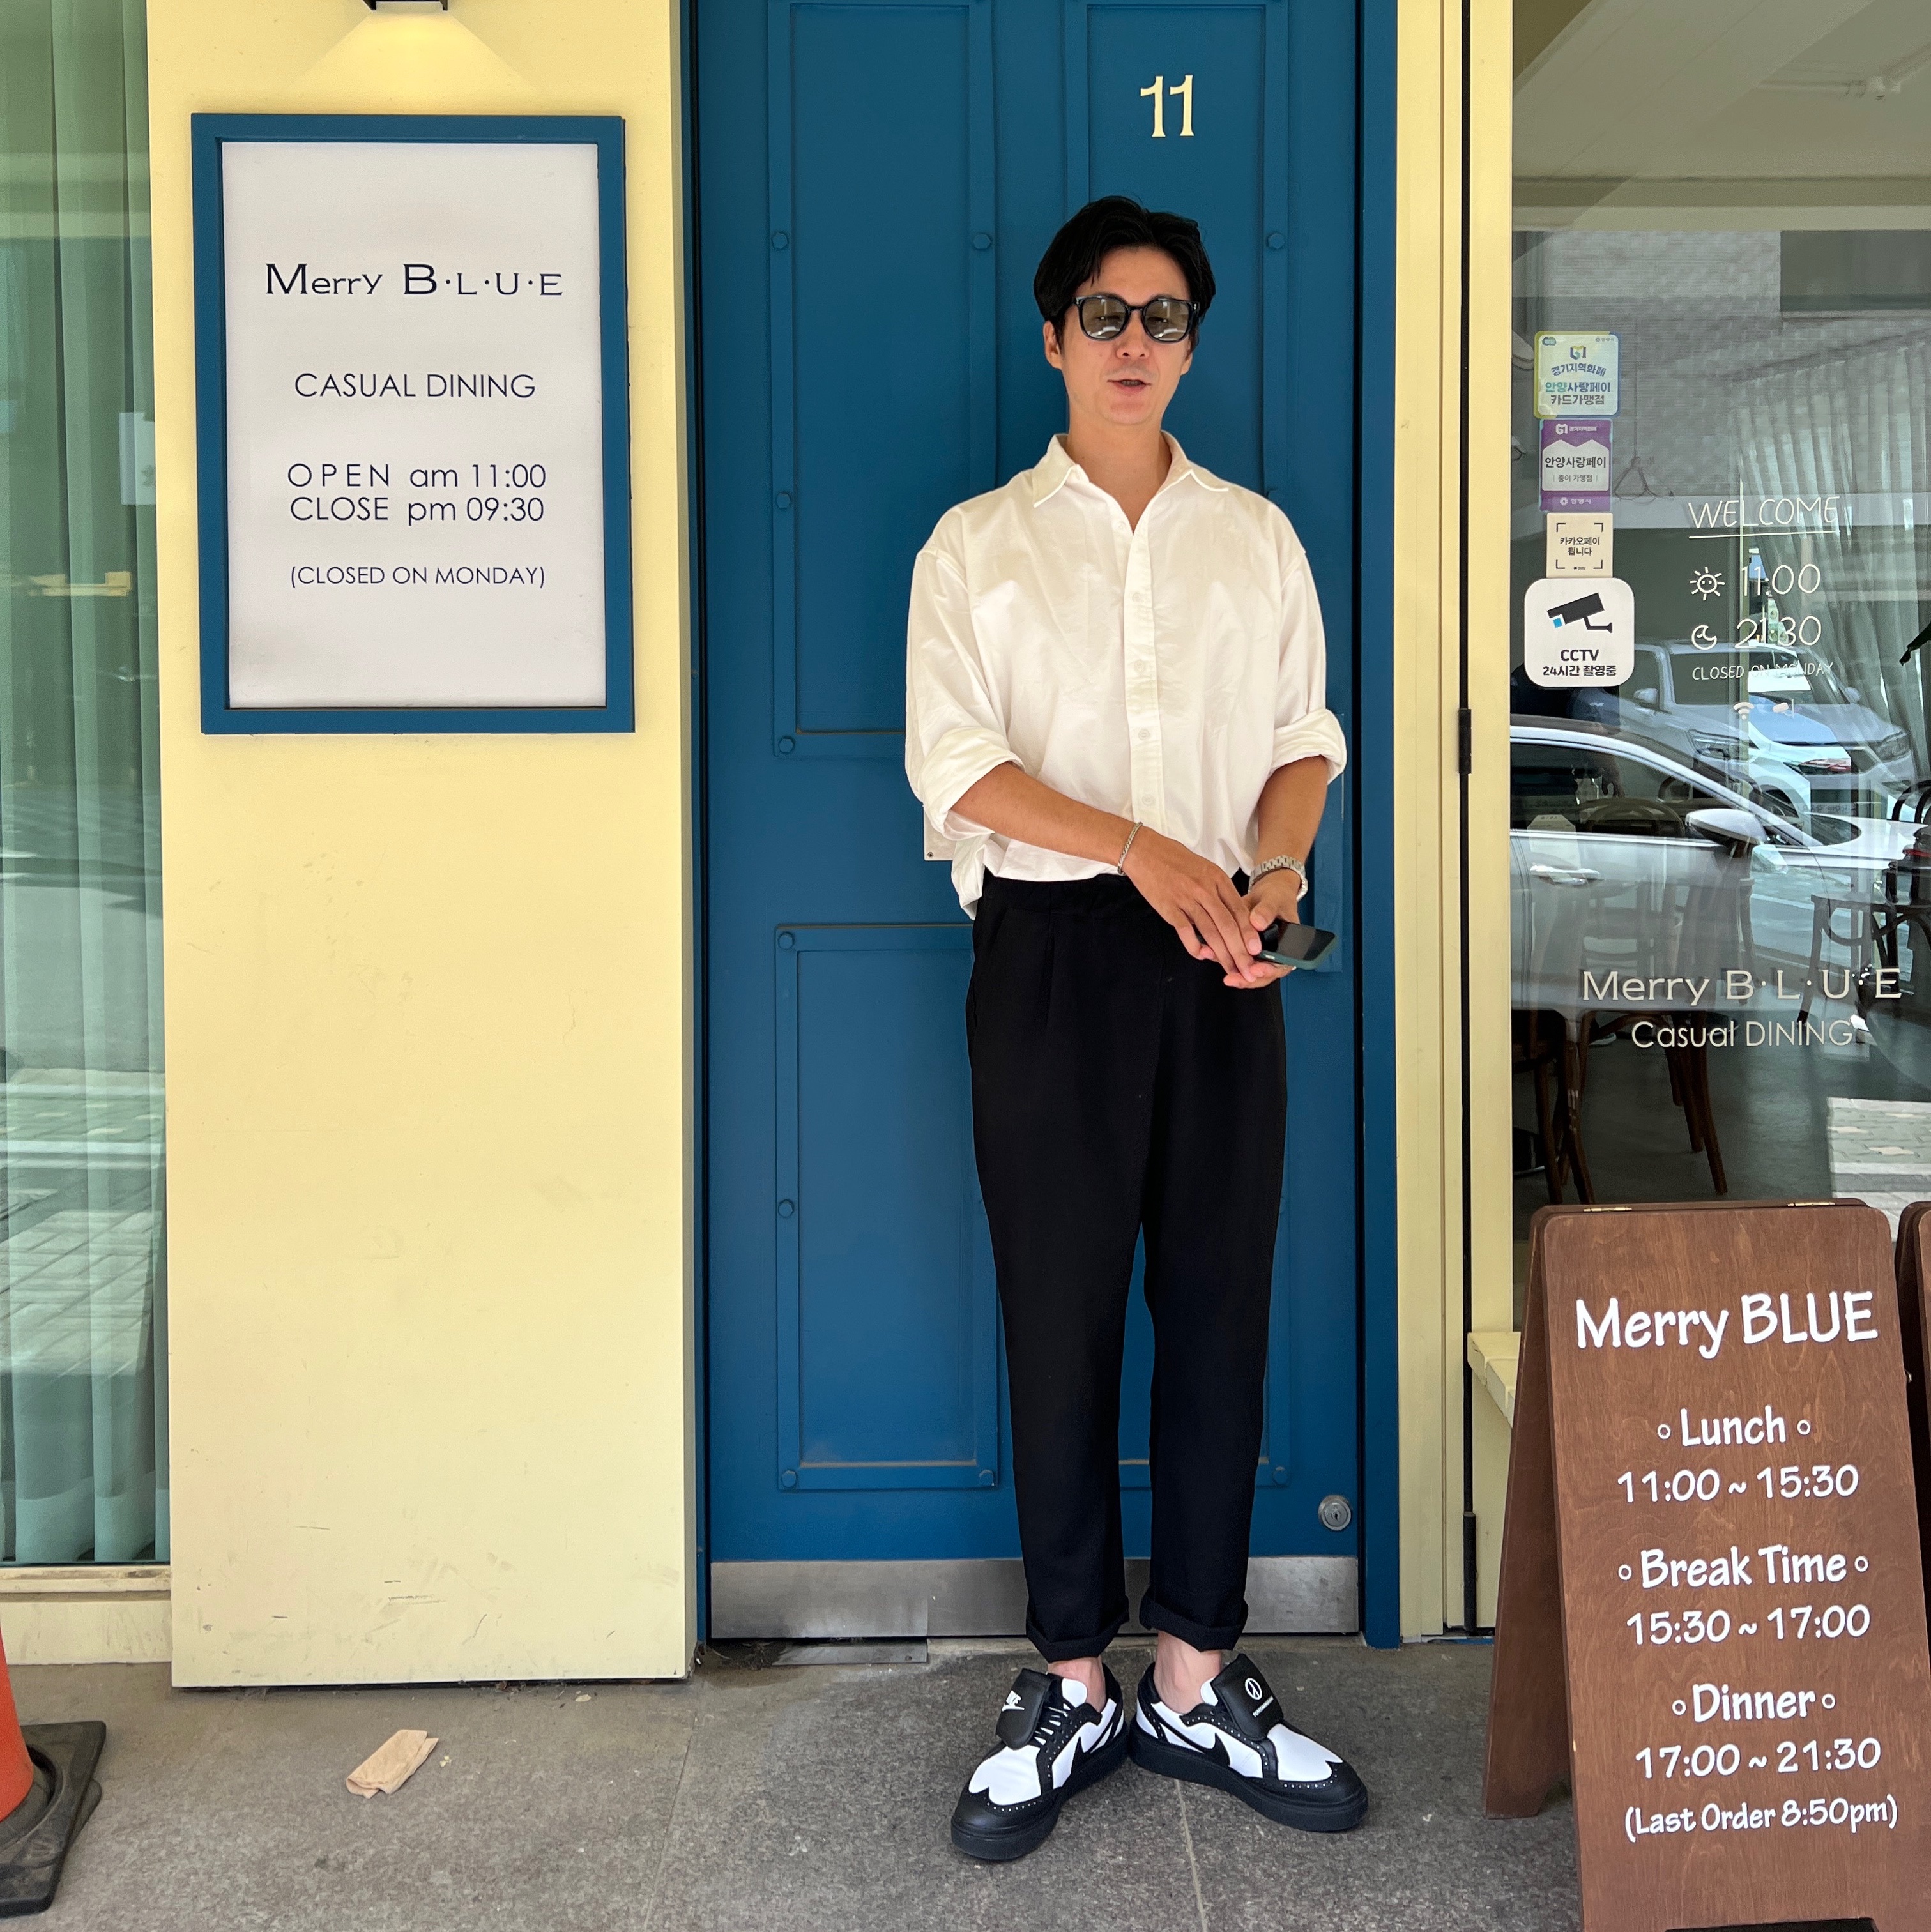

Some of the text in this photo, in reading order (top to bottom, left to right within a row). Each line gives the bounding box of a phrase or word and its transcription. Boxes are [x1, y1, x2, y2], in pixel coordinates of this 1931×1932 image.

[1140, 74, 1194, 138] 11
[266, 263, 384, 296] Merry
[295, 373, 536, 399] CASUAL DINING
[1545, 382, 1610, 393] 안양사랑페이
[1550, 394, 1605, 405] 카드가맹점
[287, 463, 547, 489] OPEN am 11:00
[1545, 457, 1607, 468] 안양사랑페이
[291, 497, 545, 527] CLOSE pm 09:30
[1688, 496, 1841, 530] WELCOME
[1560, 536, 1600, 546] 카카오페이
[1568, 547, 1592, 556] 됩니다
[291, 567, 546, 589] (CLOSED ON MONDAY)
[1740, 563, 1821, 597] 11:00
[1543, 665, 1617, 677] 24시간 촬영중
[1560, 649, 1600, 662] CCTV
[1691, 666, 1744, 680] CLOSED
[1582, 970, 1711, 1007] Merry
[1631, 1020, 1853, 1048] Casual DINING
[1576, 1291, 1879, 1360] Merry BLUE
[1680, 1404, 1787, 1447] Lunch
[1617, 1468, 1721, 1503] 11:00
[1757, 1464, 1859, 1499] 15:30
[1640, 1544, 1847, 1589] Break Time
[1626, 1609, 1731, 1645] 15:30
[1767, 1604, 1871, 1640] 17:00
[1692, 1683, 1817, 1723] Dinner
[1635, 1744, 1741, 1779] 17:00
[1776, 1737, 1882, 1774] 21:30
[1625, 1793, 1898, 1843] (Last Order 8:50pm)
